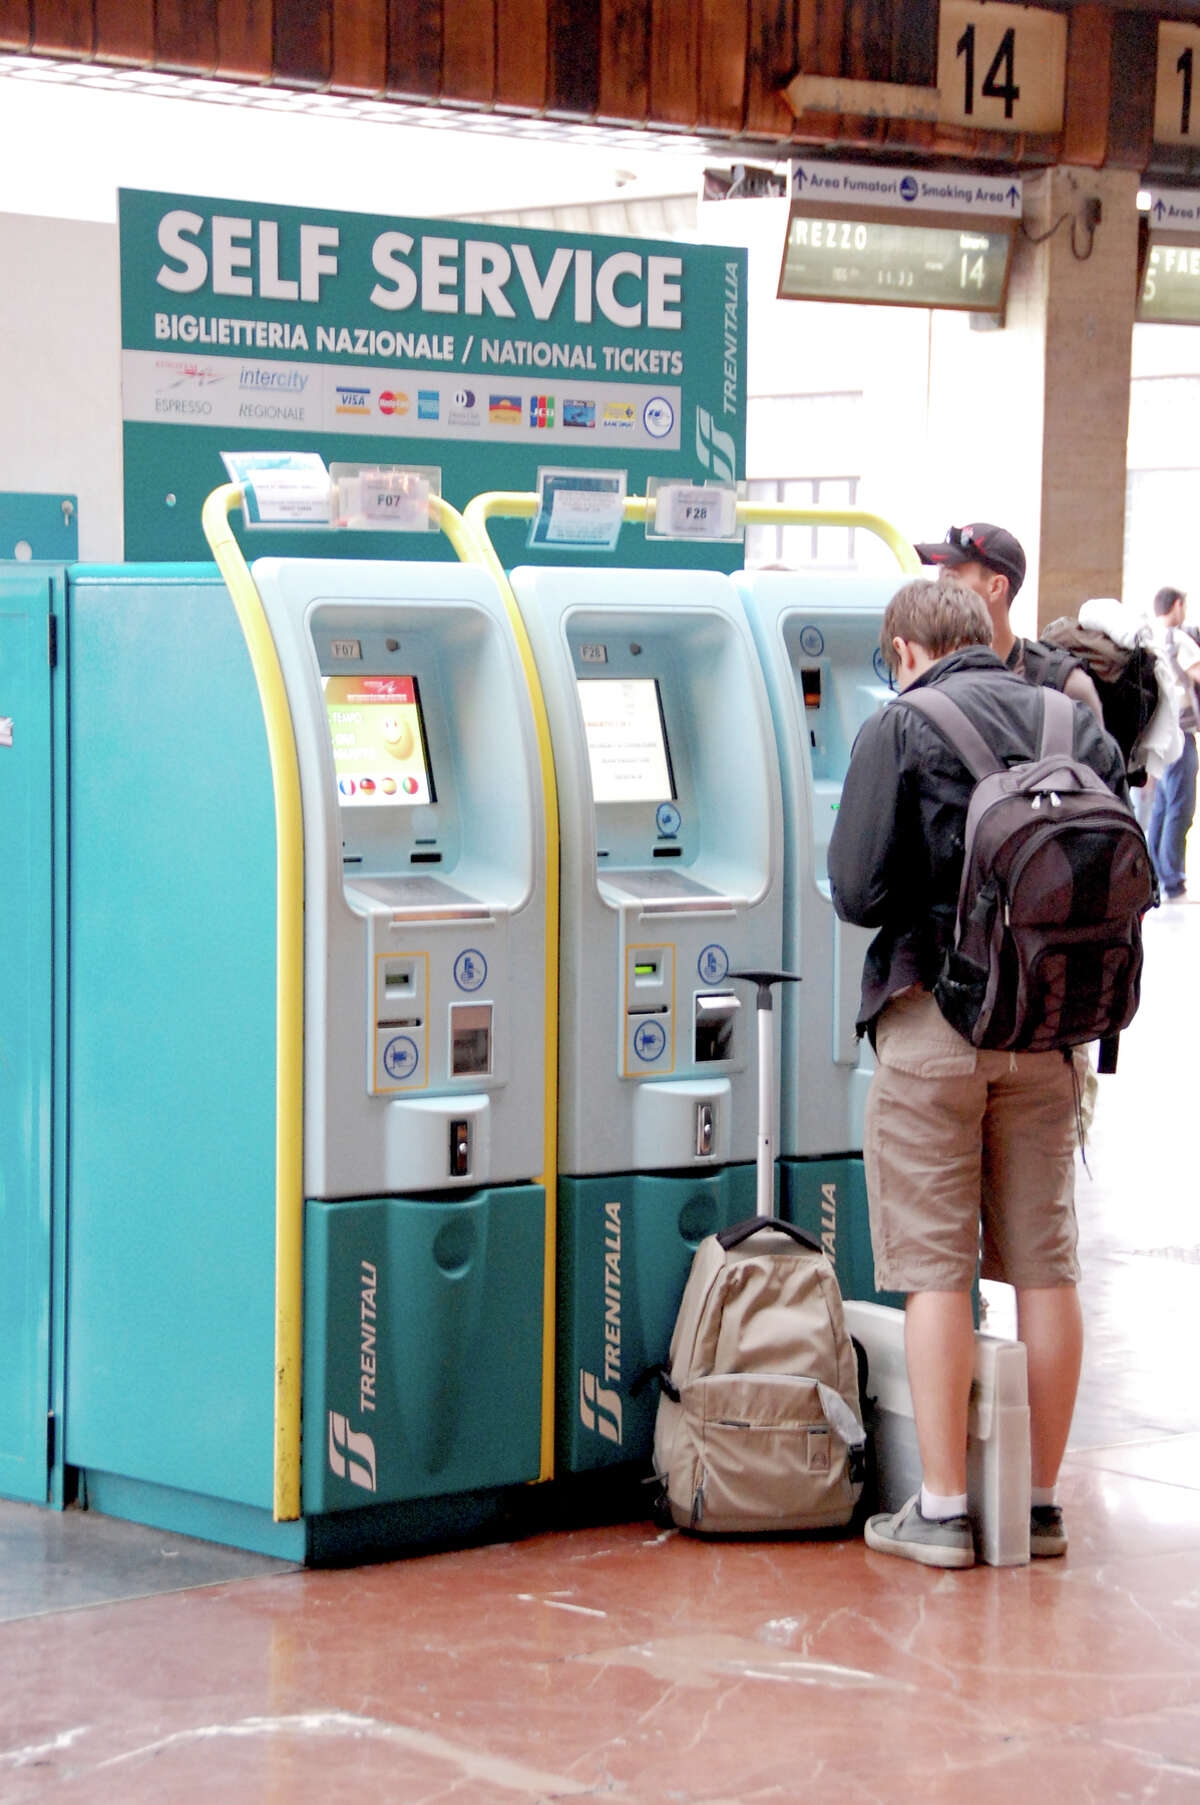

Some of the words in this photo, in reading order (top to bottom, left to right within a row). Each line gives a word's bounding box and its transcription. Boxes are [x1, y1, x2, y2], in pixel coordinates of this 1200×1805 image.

[956, 23, 1020, 119] 14
[1176, 47, 1193, 135] 1
[811, 173, 840, 188] Area
[843, 175, 897, 194] Fumatori
[921, 184, 973, 203] Smoking
[976, 187, 1005, 203] Area
[1168, 204, 1194, 219] Area
[790, 220, 868, 250] REZZO
[156, 209, 340, 303] SELF
[369, 230, 683, 330] SERVICE
[959, 252, 986, 290] 14
[154, 311, 309, 351] BIGLIETTERIA
[316, 325, 455, 361] NAZIONALE
[481, 337, 597, 371] NATIONAL
[602, 346, 684, 375] TICKETS
[723, 261, 739, 416] TRENITALIA
[240, 366, 309, 391] intercity
[155, 398, 213, 415] ESPRESSO
[239, 402, 305, 420] REGIONALE
[341, 393, 366, 406] VISA
[377, 494, 401, 508] F07
[685, 507, 707, 520] F28
[335, 643, 355, 657] F07
[582, 646, 602, 659] F28
[604, 1201, 622, 1382] TRENITALIA
[360, 1260, 377, 1414] TRENITALI
